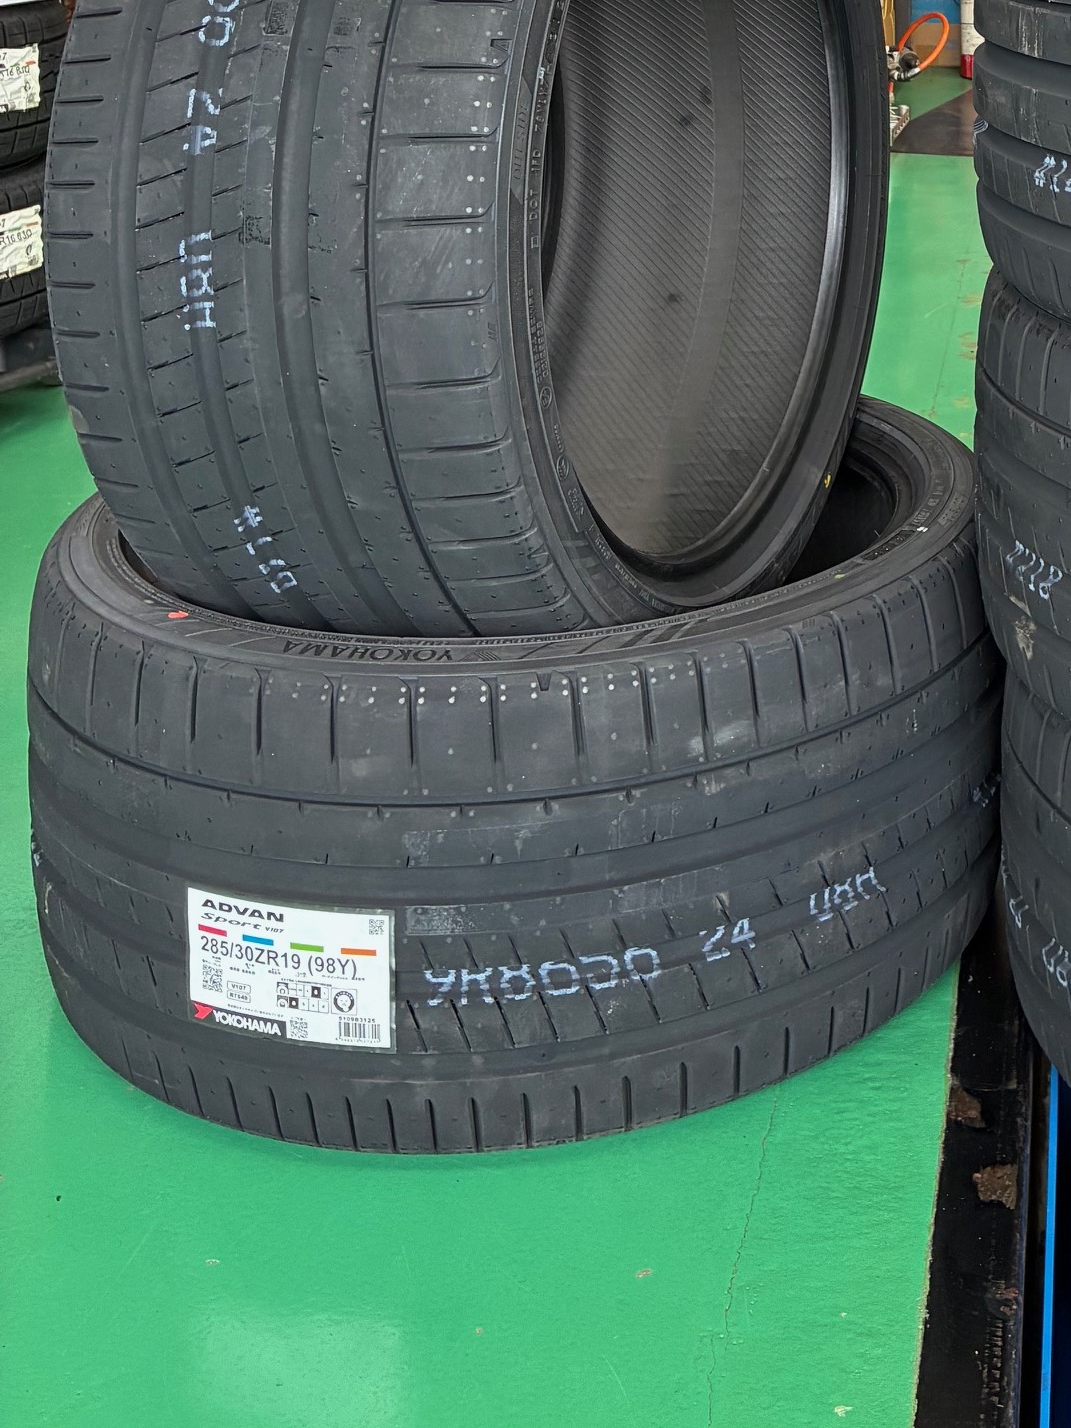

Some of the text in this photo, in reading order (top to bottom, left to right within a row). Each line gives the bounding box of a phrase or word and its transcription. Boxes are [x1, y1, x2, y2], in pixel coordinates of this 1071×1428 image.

[286, 639, 451, 662] YOKOHAMA
[201, 899, 284, 922] ADVAN
[200, 913, 284, 934] Sport V107
[201, 936, 357, 980] 285/30ZR19 (98Y)
[231, 983, 247, 991] V107
[213, 1010, 282, 1035] YOKOHAMA
